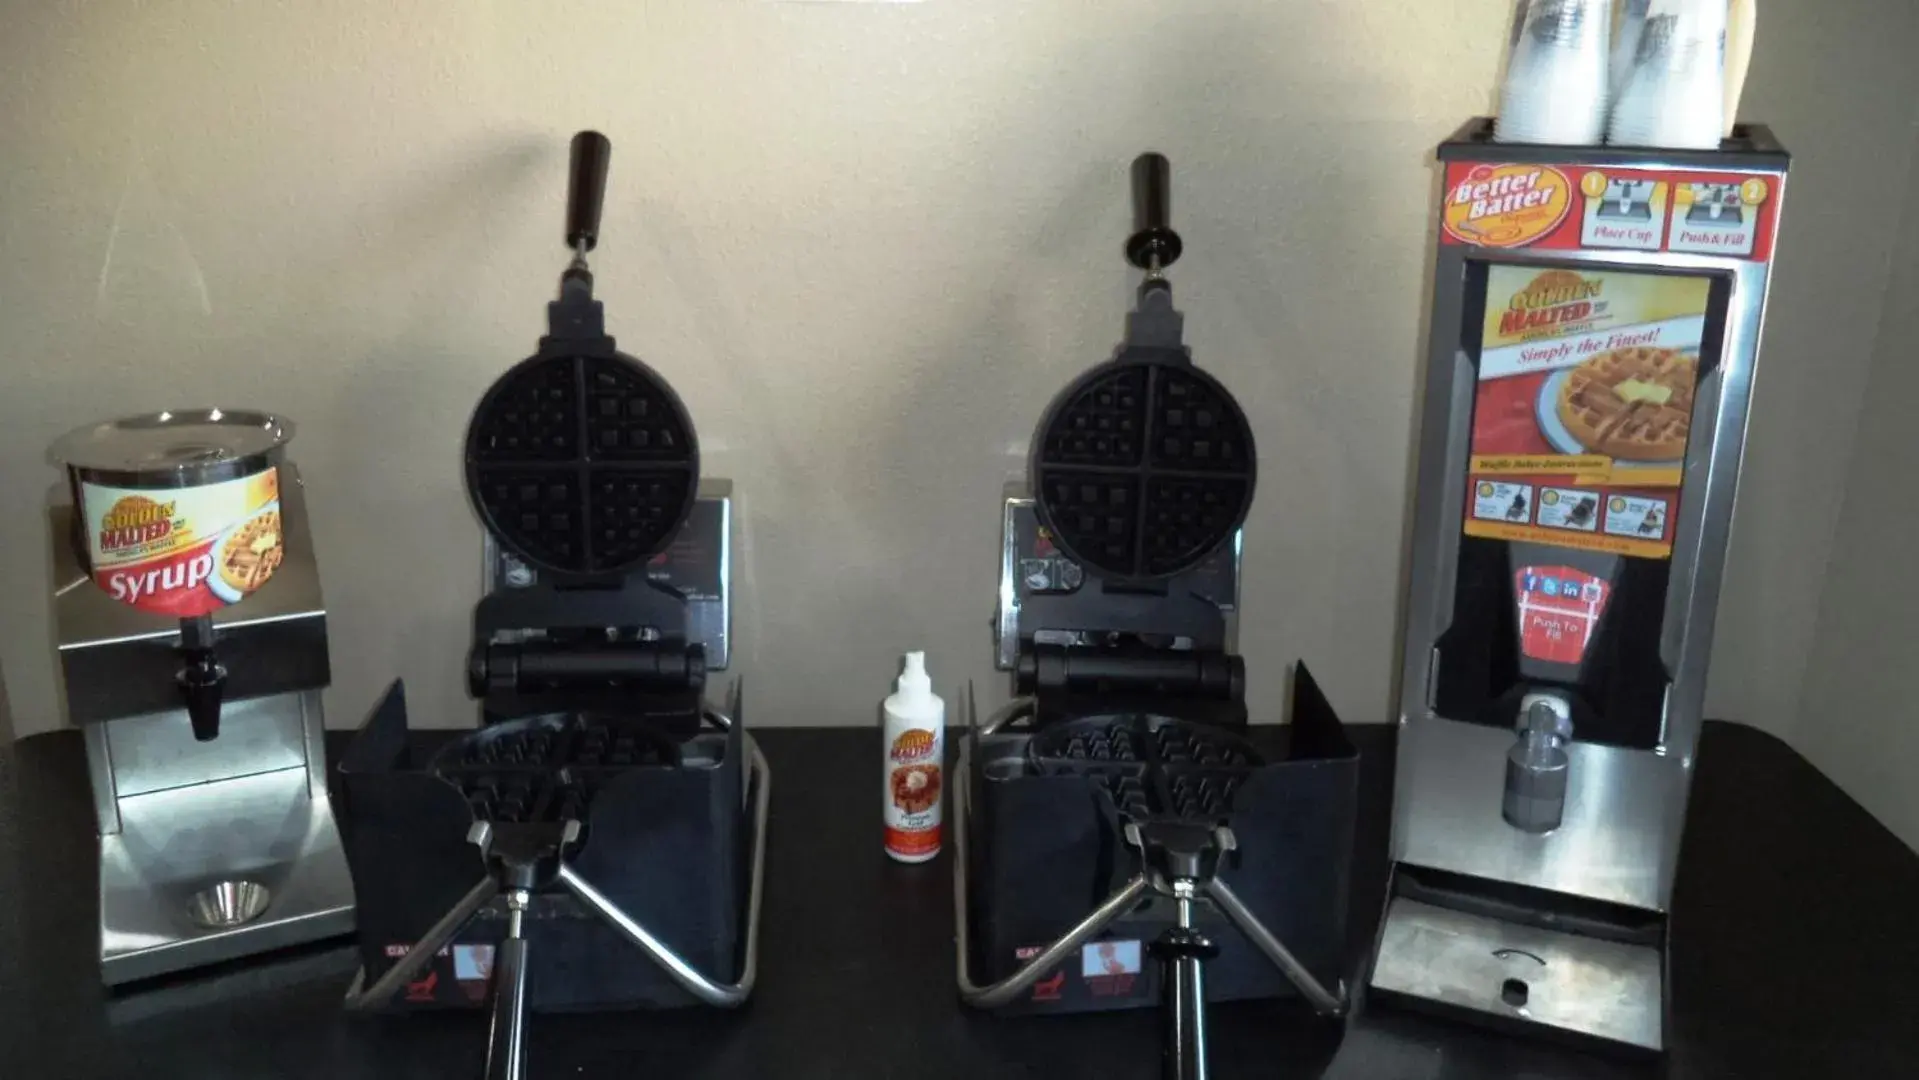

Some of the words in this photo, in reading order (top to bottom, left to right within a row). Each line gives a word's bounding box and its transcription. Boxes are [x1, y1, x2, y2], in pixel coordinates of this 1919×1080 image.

[1454, 169, 1542, 205] Better
[1468, 185, 1556, 221] Batter
[1594, 226, 1624, 239] Place
[1627, 227, 1653, 243] Cup
[1680, 231, 1711, 244] Push
[1723, 233, 1746, 246] Fill
[1499, 301, 1592, 336] MALTED
[1517, 342, 1576, 365] Simply
[1577, 337, 1602, 353] the
[1606, 328, 1661, 349] Finest!
[102, 501, 176, 532] GOLDEN
[99, 519, 172, 554] MALTED
[109, 553, 213, 604] Syrup
[1533, 615, 1560, 629] Push
[1564, 620, 1578, 632] To
